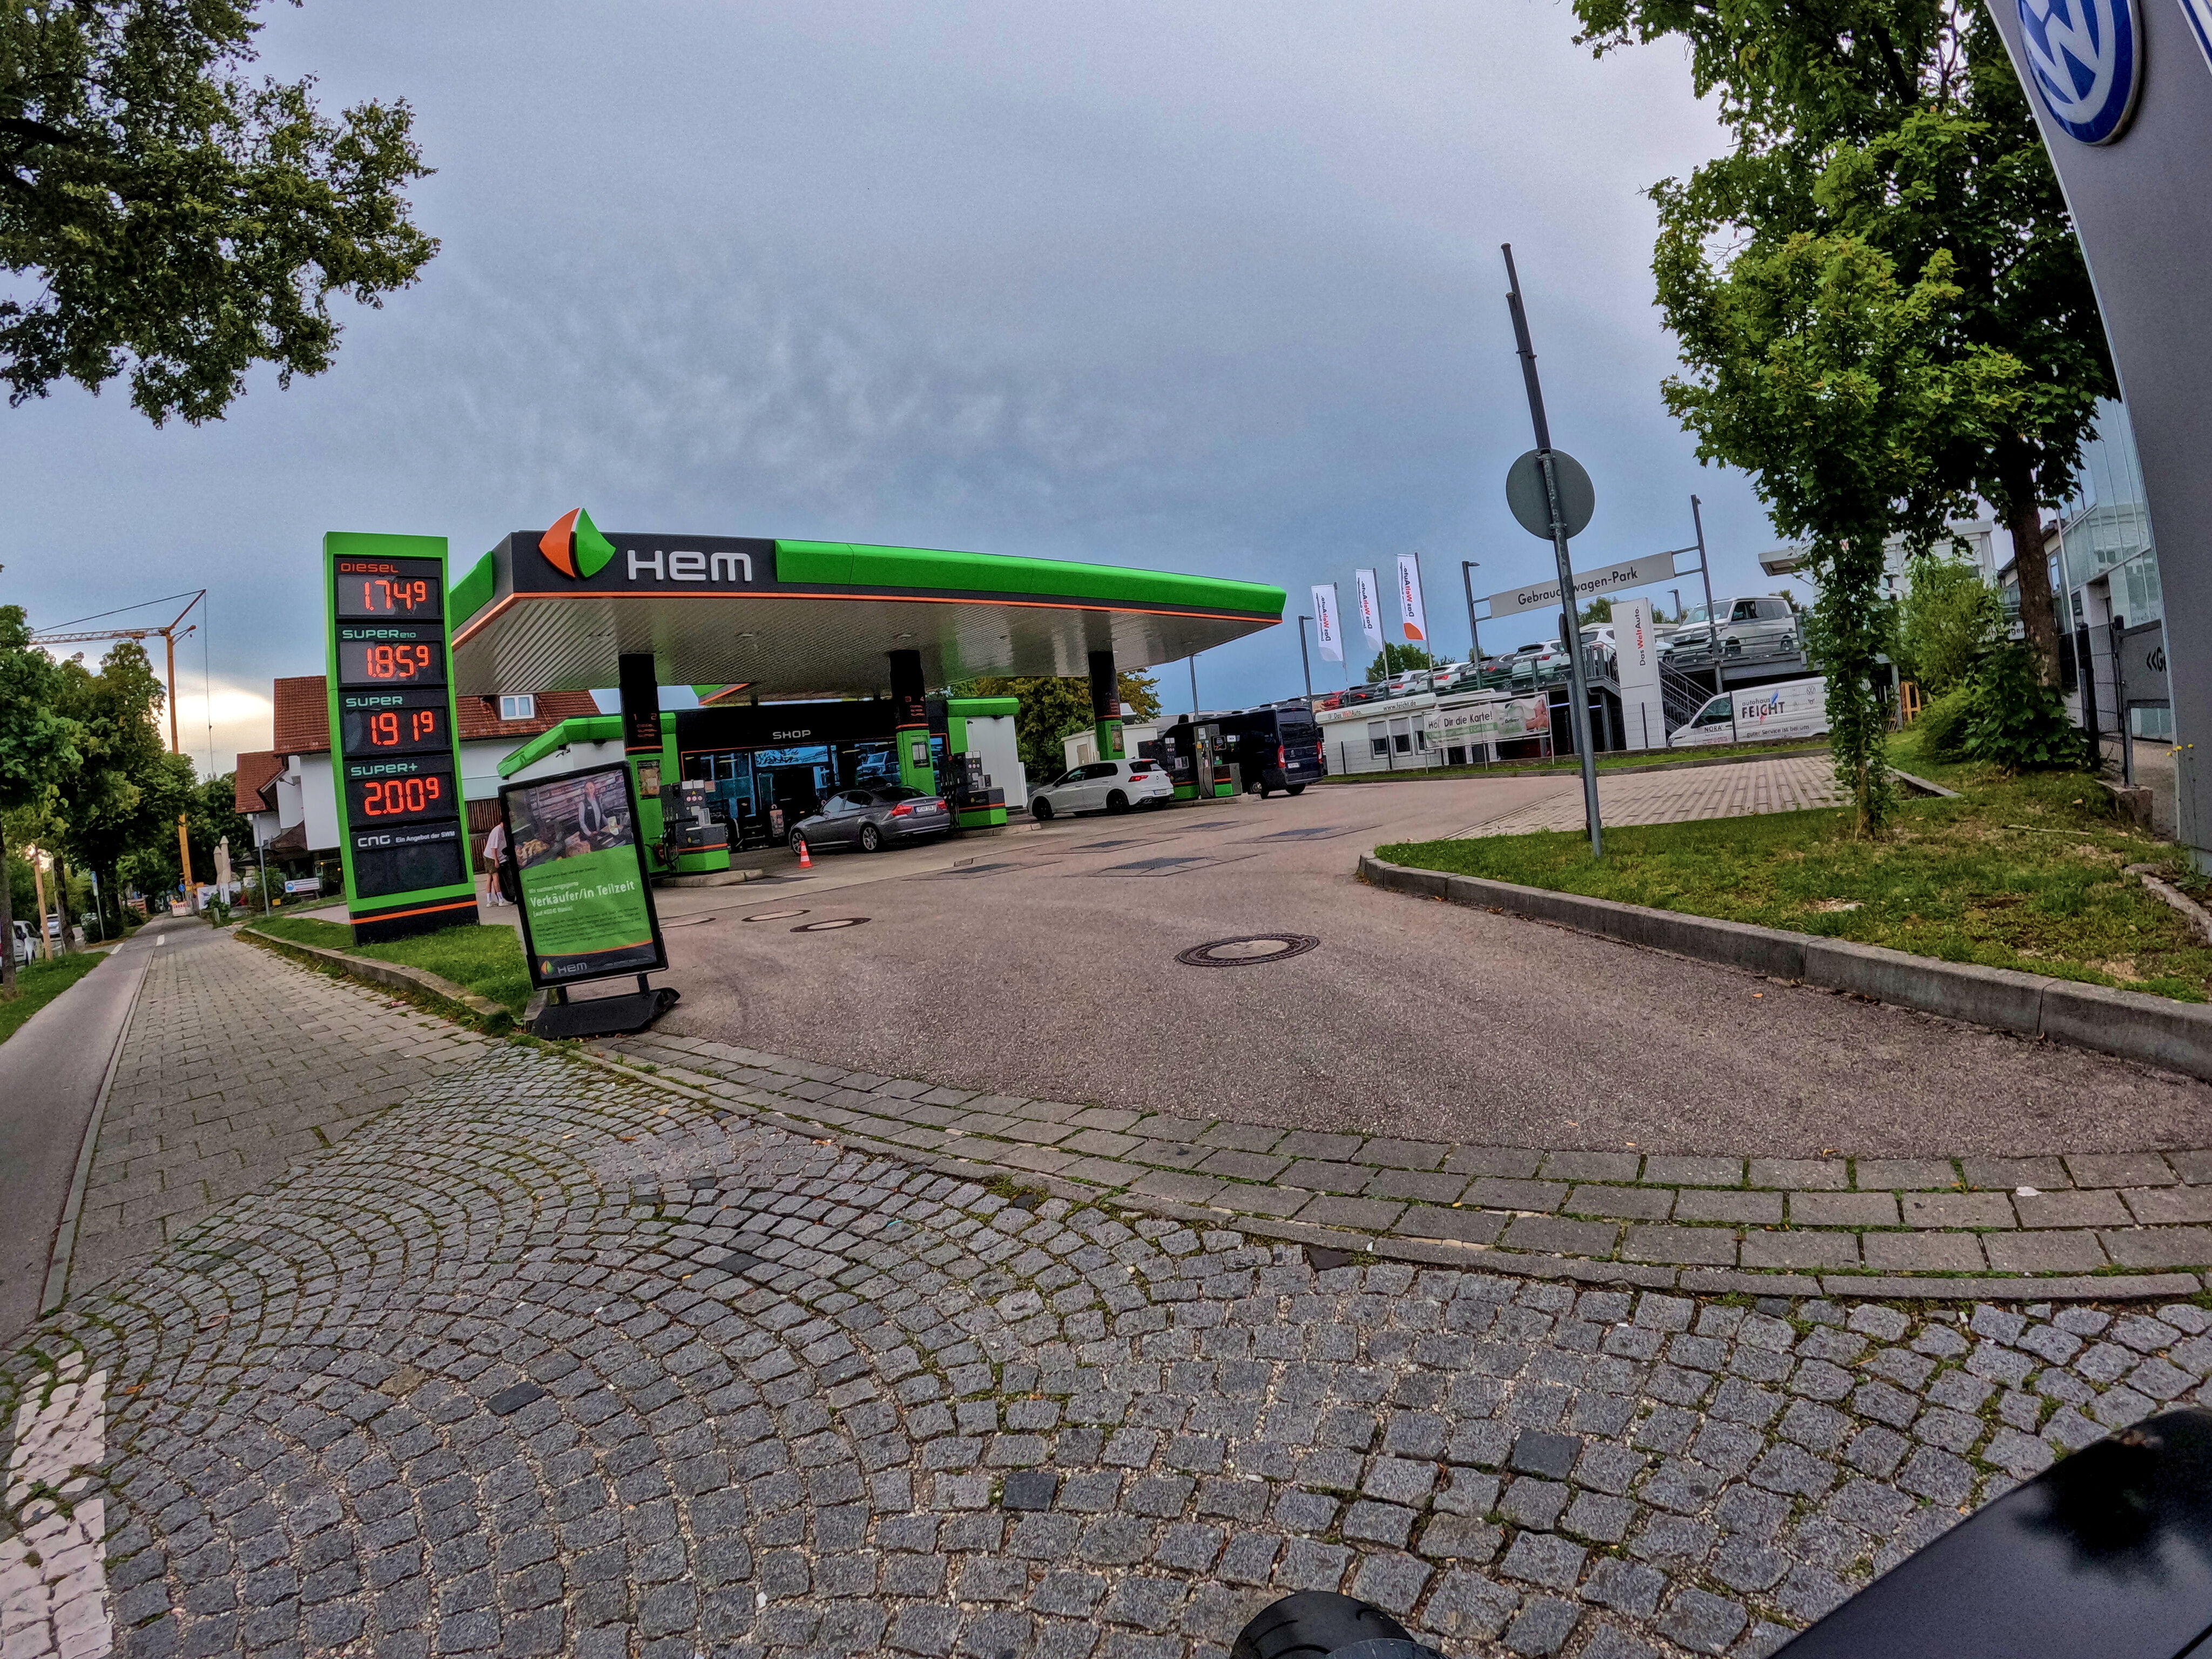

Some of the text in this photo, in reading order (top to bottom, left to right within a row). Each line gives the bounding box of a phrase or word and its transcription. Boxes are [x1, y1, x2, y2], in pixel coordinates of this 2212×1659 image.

[340, 563, 399, 573] DIESEL
[342, 629, 399, 639] SUPER
[346, 696, 403, 707] SUPER
[1383, 700, 1417, 711] www.feicht.de
[1742, 698, 1771, 706] autohaus
[1742, 702, 1785, 719] FEICHT
[1444, 717, 1453, 727] Dir
[1456, 716, 1467, 725] die
[1469, 711, 1493, 723] Karte!
[772, 730, 811, 739] SHOP
[358, 835, 390, 847] CNG
